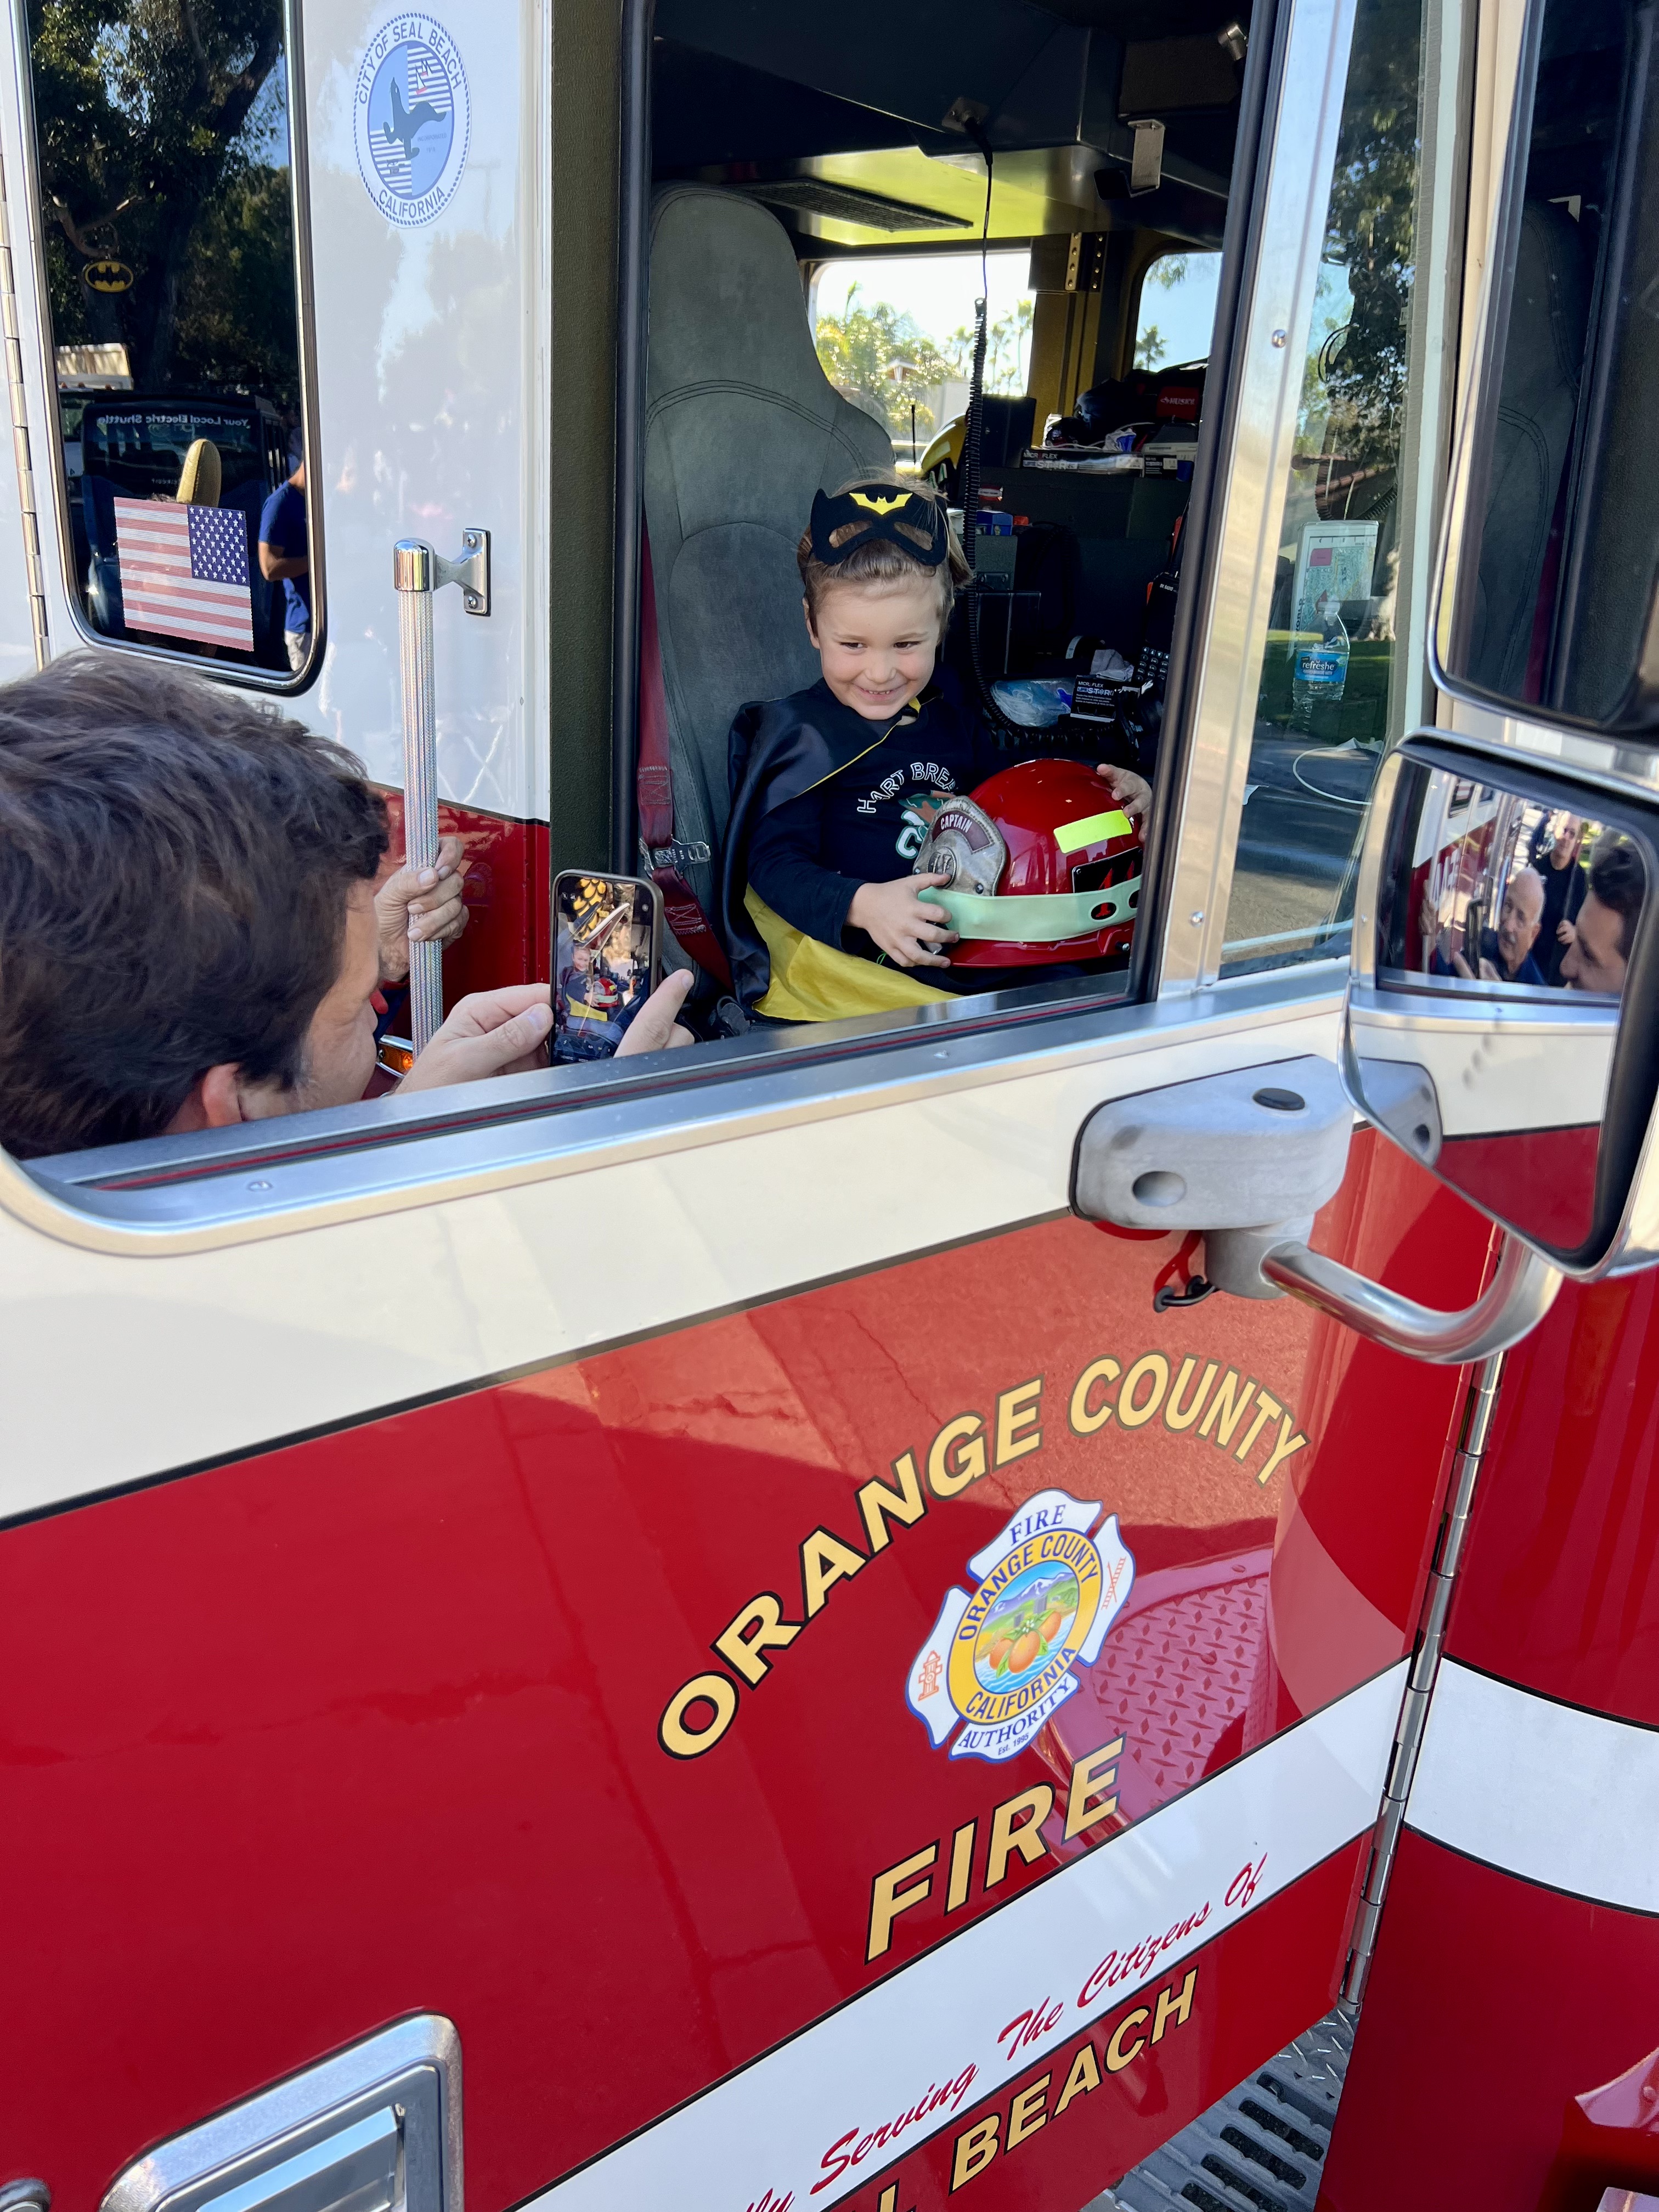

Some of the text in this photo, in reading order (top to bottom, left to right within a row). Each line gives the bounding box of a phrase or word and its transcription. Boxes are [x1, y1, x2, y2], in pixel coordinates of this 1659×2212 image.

[359, 21, 461, 104] CITY OF SEAL BEACH
[417, 133, 447, 142] INCORPORATED
[379, 186, 445, 218] CALIFORNIA
[1302, 661, 1335, 670] refreshe
[857, 762, 956, 813] HART BREA
[940, 814, 973, 833] CAPTAIN
[658, 1349, 1311, 1760] ORANGE COUNTY
[1009, 1504, 1066, 1546] FIRE
[958, 1534, 1098, 1640] ORANGE COUNTY
[958, 1676, 1070, 1748] AUTHORITY
[966, 1647, 1076, 1719] CALIFORNIA
[998, 1733, 1029, 1756] Est. 1995
[865, 1733, 1126, 1964] FIRE
[810, 2062, 979, 2195] Serving
[997, 1996, 1064, 2061] The
[1076, 1900, 1213, 2008] Citizens
[1224, 1852, 1268, 1908] Of
[949, 1964, 1200, 2197] BEACH
